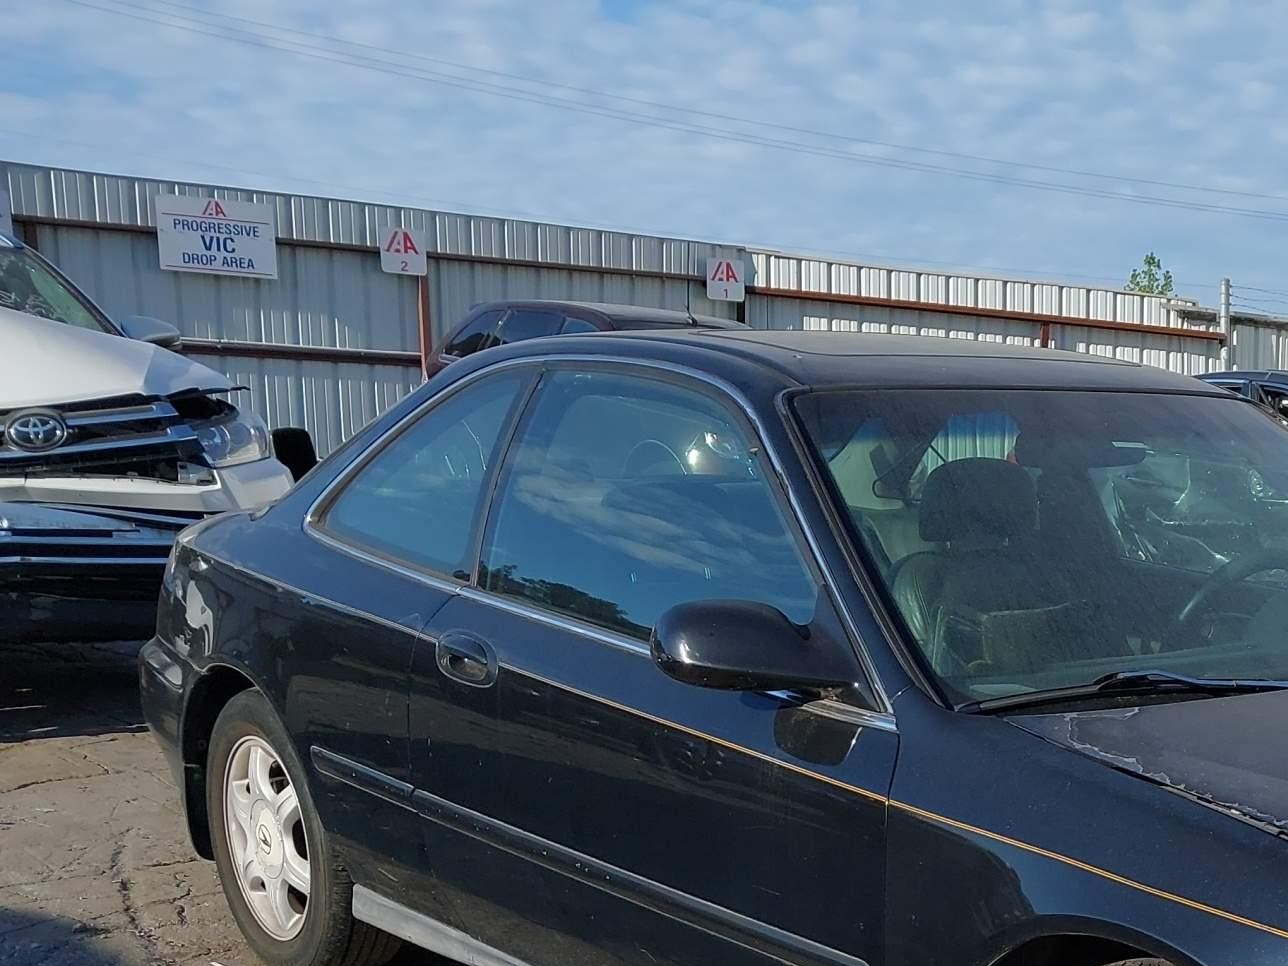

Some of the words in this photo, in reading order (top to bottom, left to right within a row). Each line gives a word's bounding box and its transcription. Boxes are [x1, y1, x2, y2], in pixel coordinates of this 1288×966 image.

[173, 218, 260, 238] PROGRESSIVE
[200, 235, 236, 254] VIC
[182, 252, 217, 266] DROP
[222, 256, 255, 270] AREA
[400, 260, 409, 272] 2
[723, 288, 729, 298] 1
